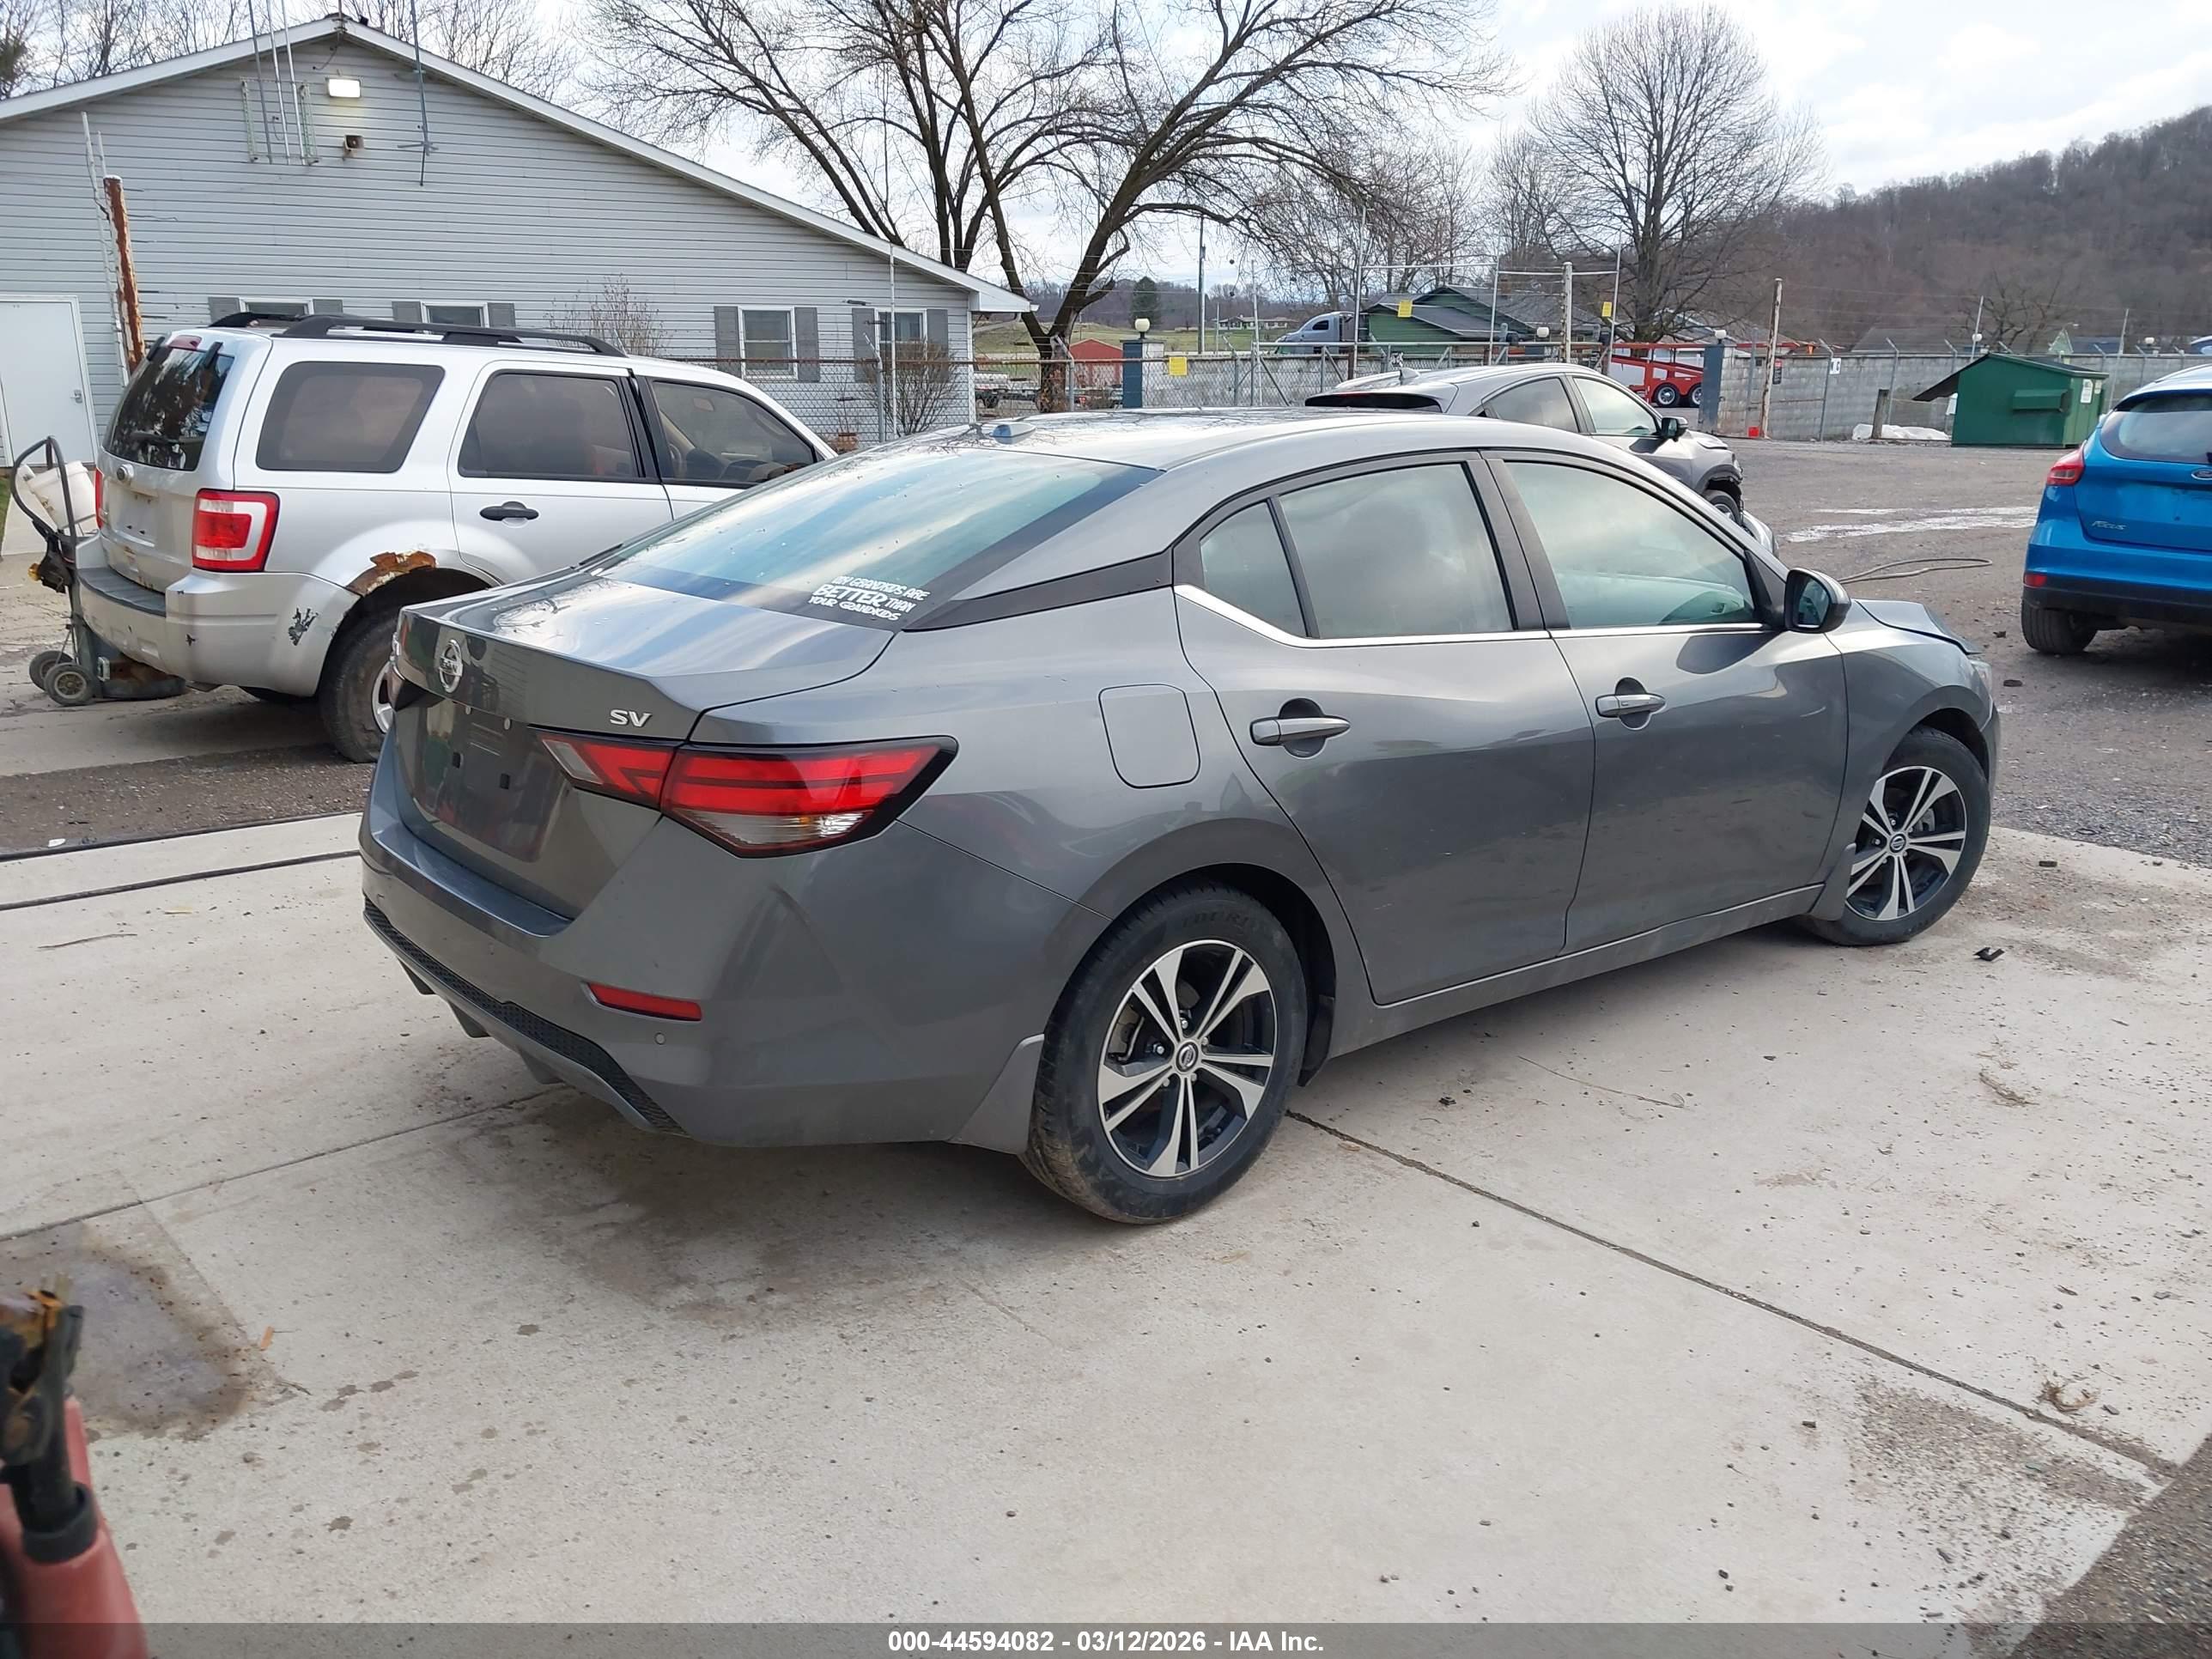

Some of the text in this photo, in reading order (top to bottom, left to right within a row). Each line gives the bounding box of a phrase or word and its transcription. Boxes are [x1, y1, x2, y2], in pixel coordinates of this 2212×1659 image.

[813, 584, 916, 612] BETTER THAN
[831, 576, 931, 600] MY GRANDKIDS ARE
[808, 596, 902, 621] YOUR GRANDKIDS
[610, 709, 653, 727] SV
